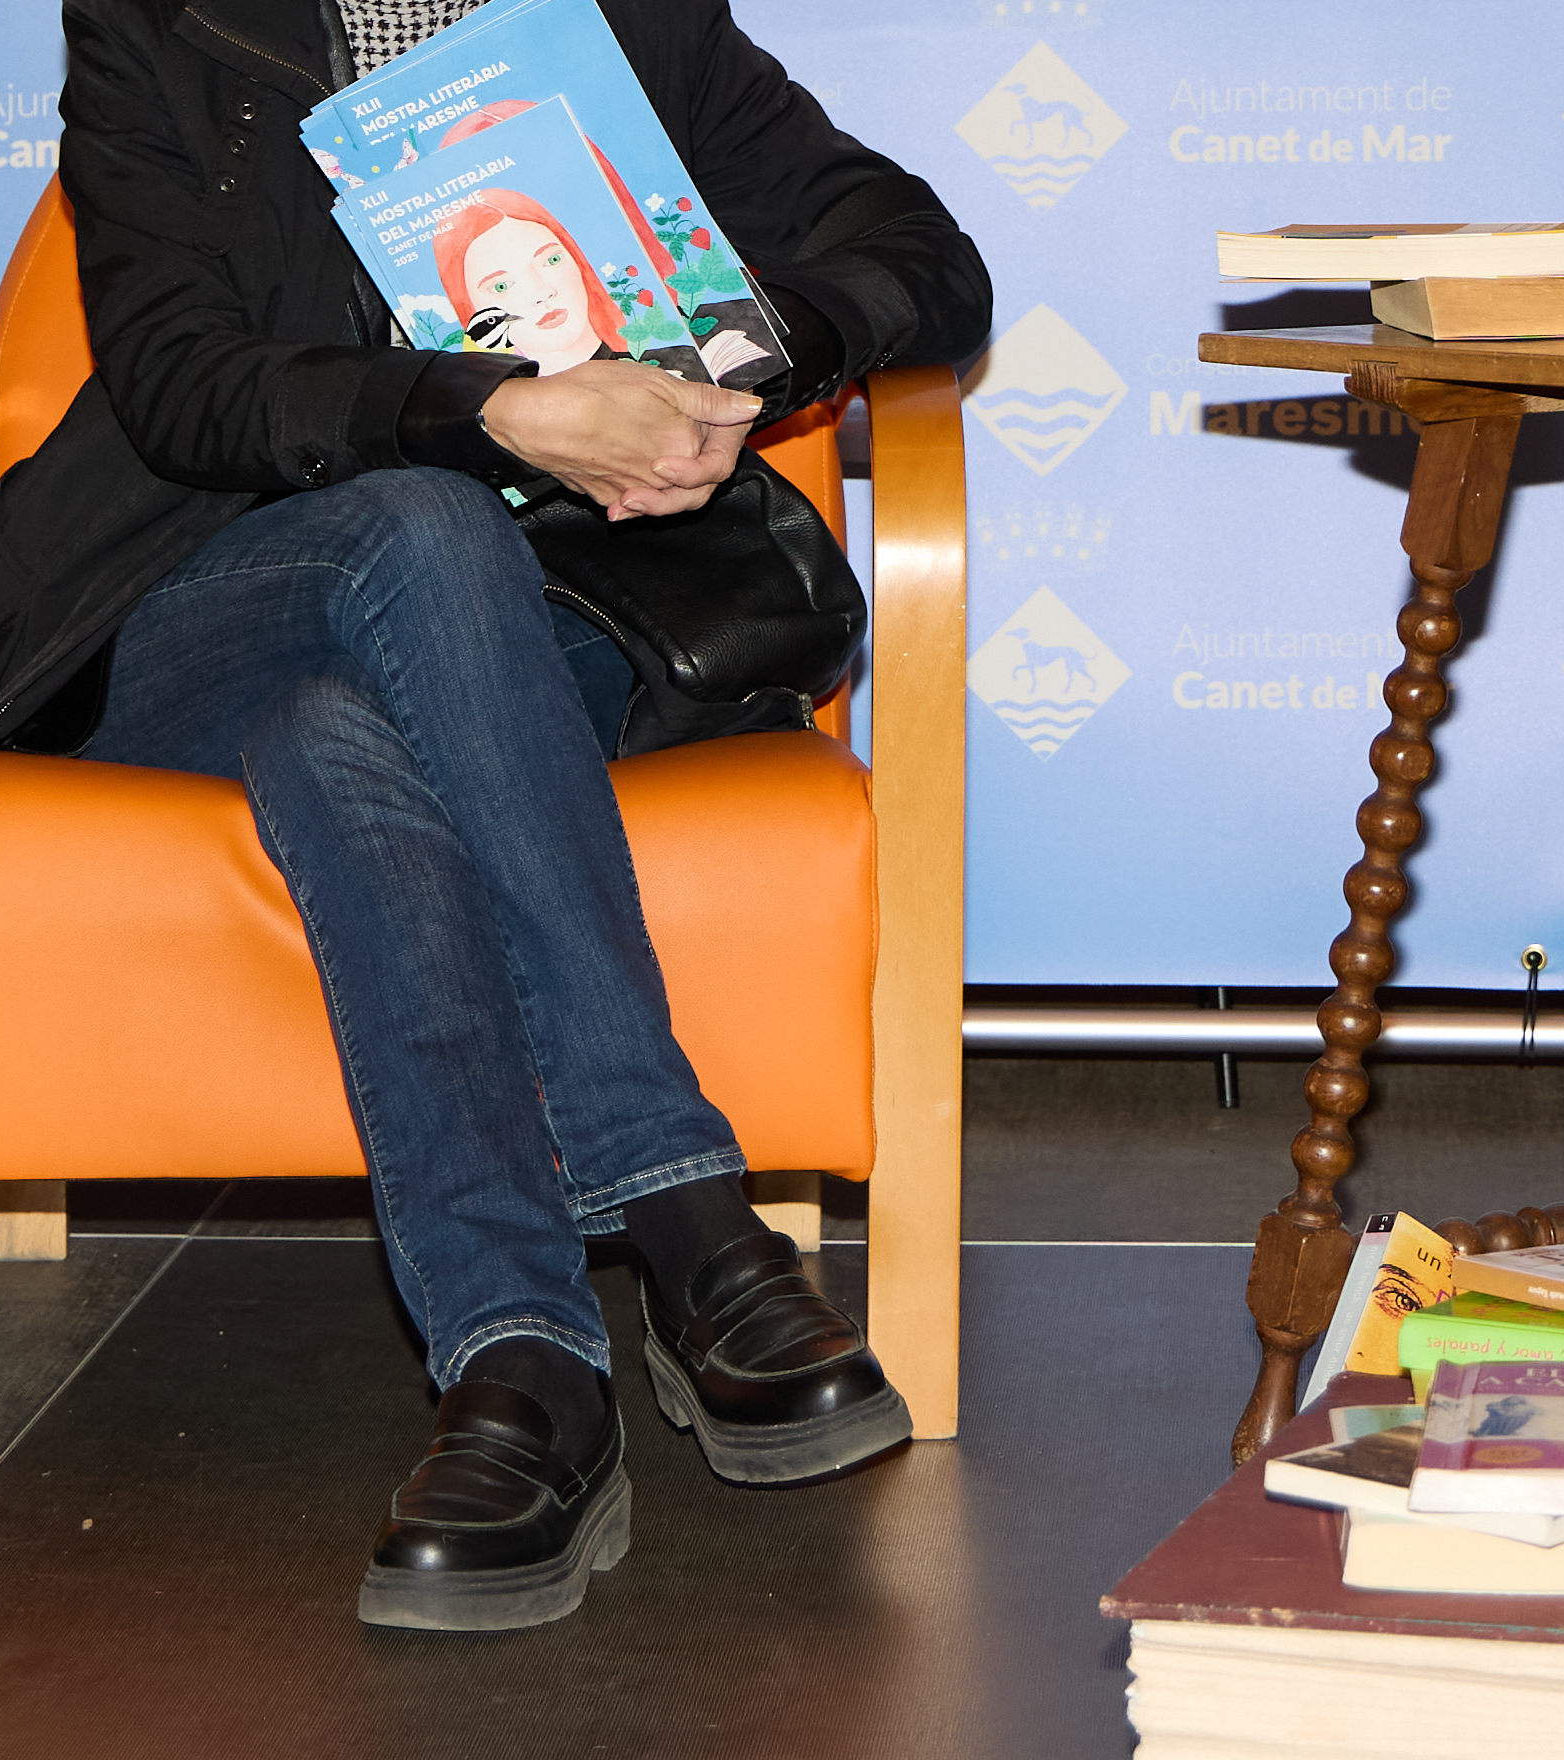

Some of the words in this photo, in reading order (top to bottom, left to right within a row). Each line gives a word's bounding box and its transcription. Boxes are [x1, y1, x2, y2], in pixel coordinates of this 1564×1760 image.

[351, 97, 382, 119] XLII
[361, 98, 430, 136] MOSTRA
[429, 60, 511, 105] LITERÀRIA
[359, 191, 389, 211] XLII
[369, 191, 436, 228] MOSTRA
[435, 155, 516, 199] LITERÀRIA
[377, 225, 409, 245] DEL
[408, 189, 485, 232] MARESME
[387, 237, 418, 256] CANET
[418, 231, 432, 242] DE
[433, 222, 455, 238] MAR
[393, 251, 419, 268] 2025
[1172, 671, 1305, 712] Canet
[1308, 675, 1358, 711] de
[1417, 1247, 1442, 1272] un
[1426, 1337, 1491, 1356] pañales
[1496, 1339, 1506, 1357] y
[1512, 1347, 1553, 1361] amor
